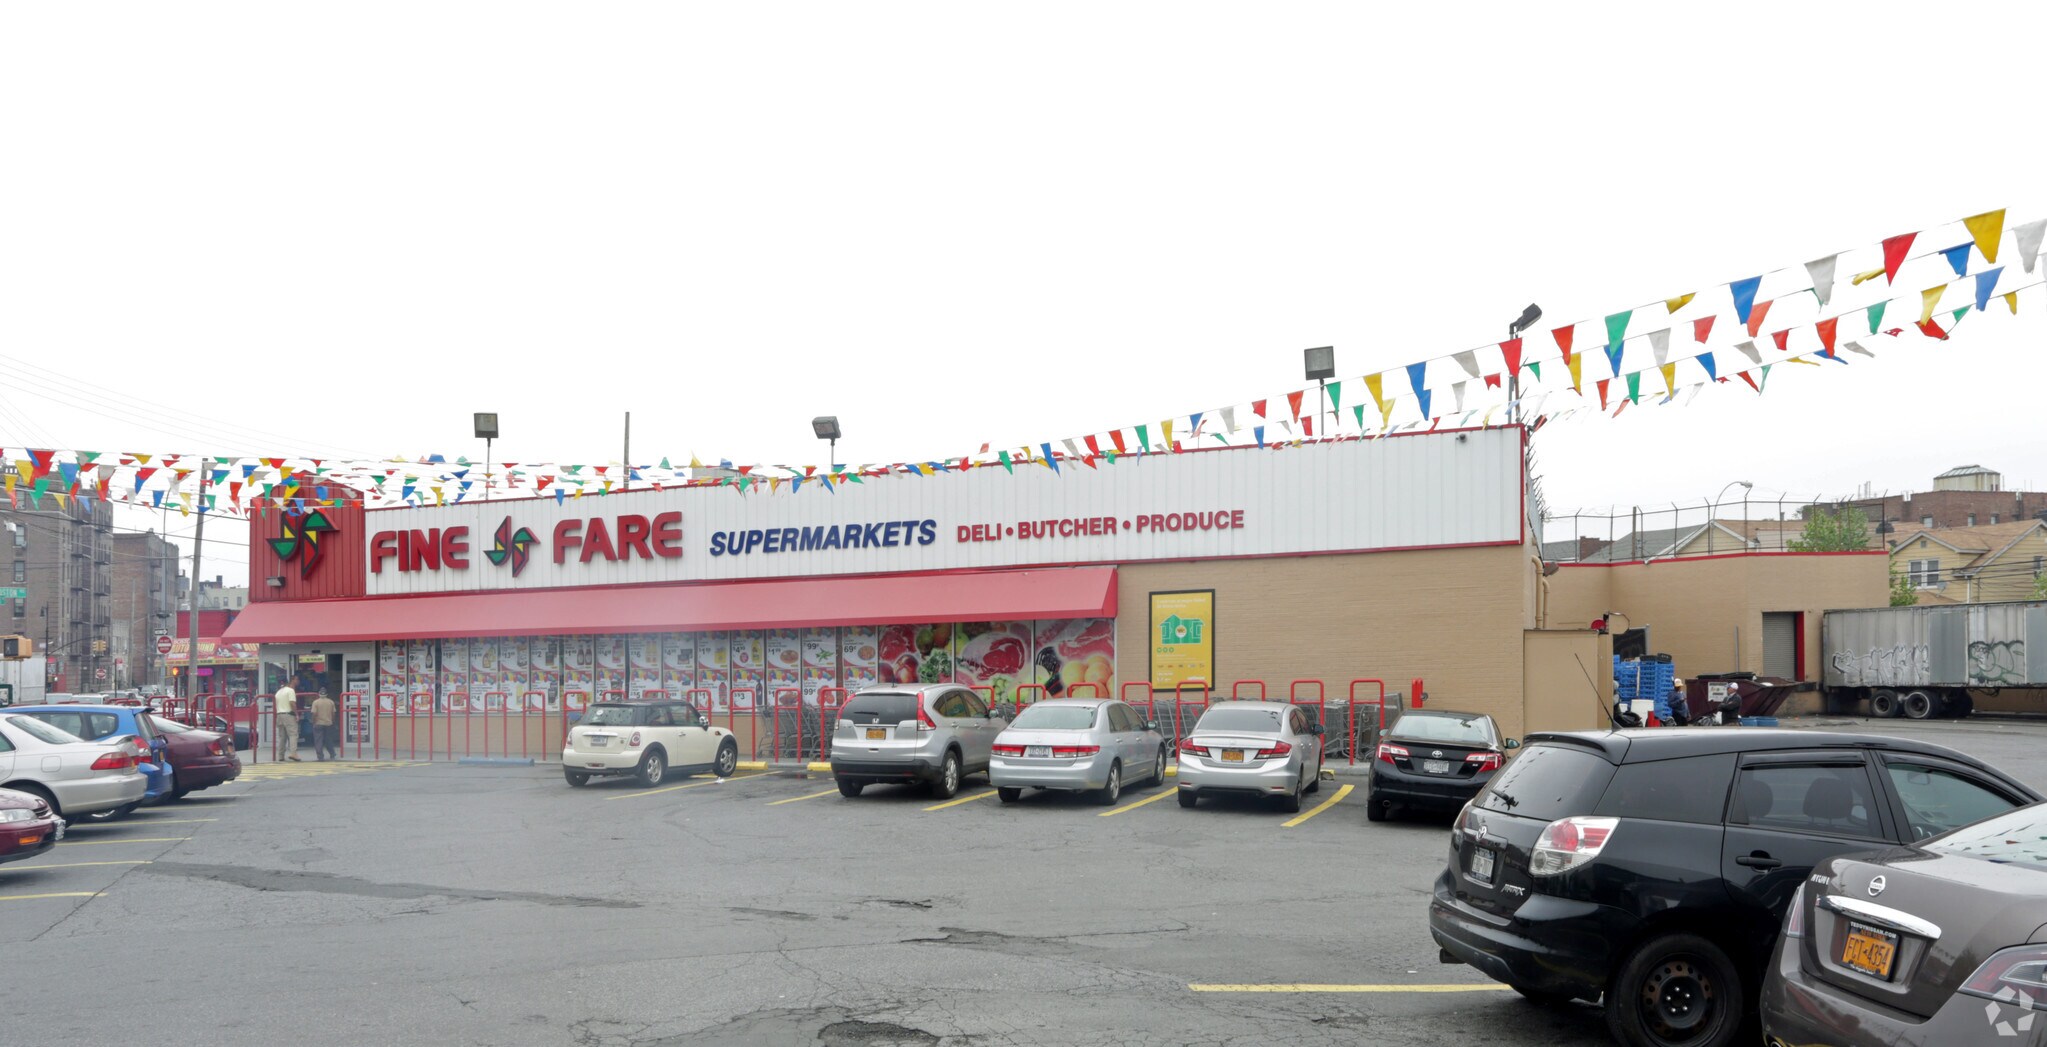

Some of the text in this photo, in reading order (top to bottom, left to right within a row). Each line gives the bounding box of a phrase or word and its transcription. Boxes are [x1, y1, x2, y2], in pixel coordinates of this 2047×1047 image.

[371, 511, 683, 573] FINE FARE
[709, 519, 937, 556] SUPERMARKETS
[957, 510, 1245, 543] DELI BUTCHER PRODUCE
